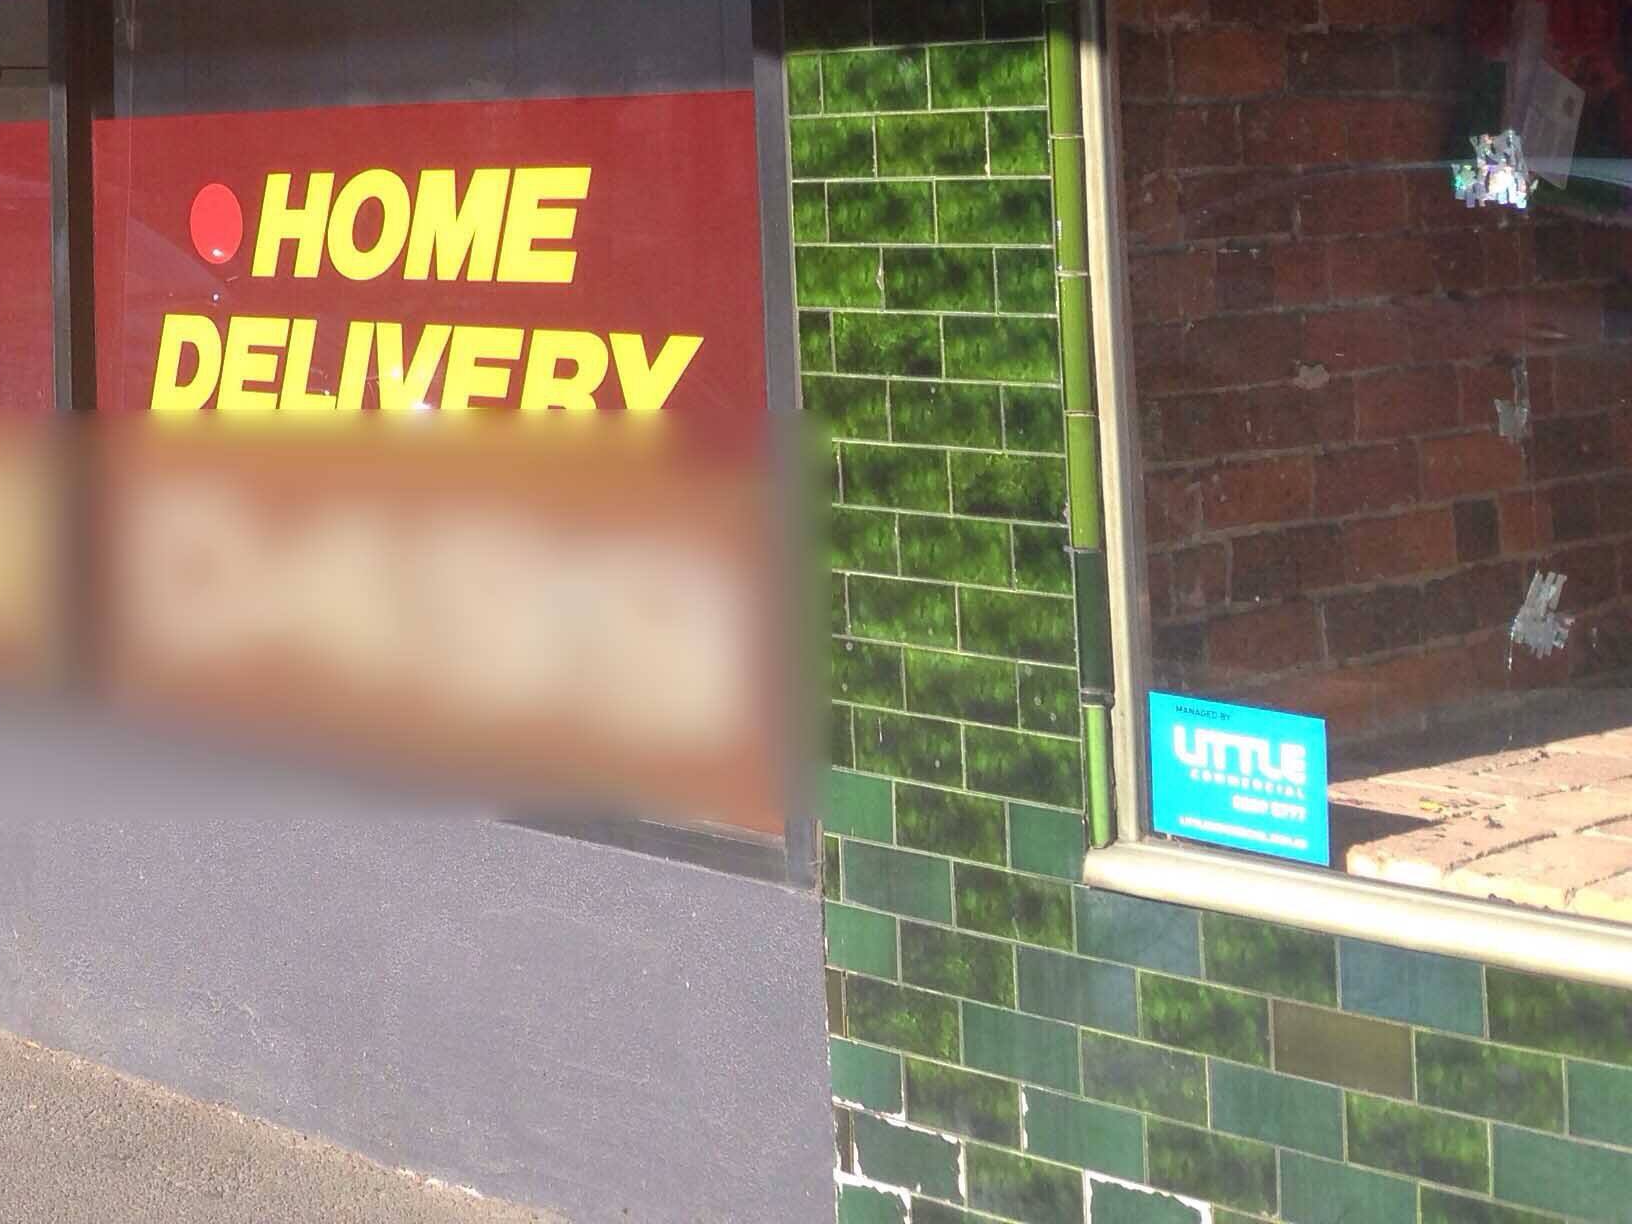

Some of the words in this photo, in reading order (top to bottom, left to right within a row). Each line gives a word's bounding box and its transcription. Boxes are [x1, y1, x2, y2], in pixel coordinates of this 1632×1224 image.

[250, 163, 592, 284] HOME
[1175, 704, 1217, 720] MANAGED
[1219, 712, 1231, 721] BY
[1173, 724, 1307, 784] LITTLE
